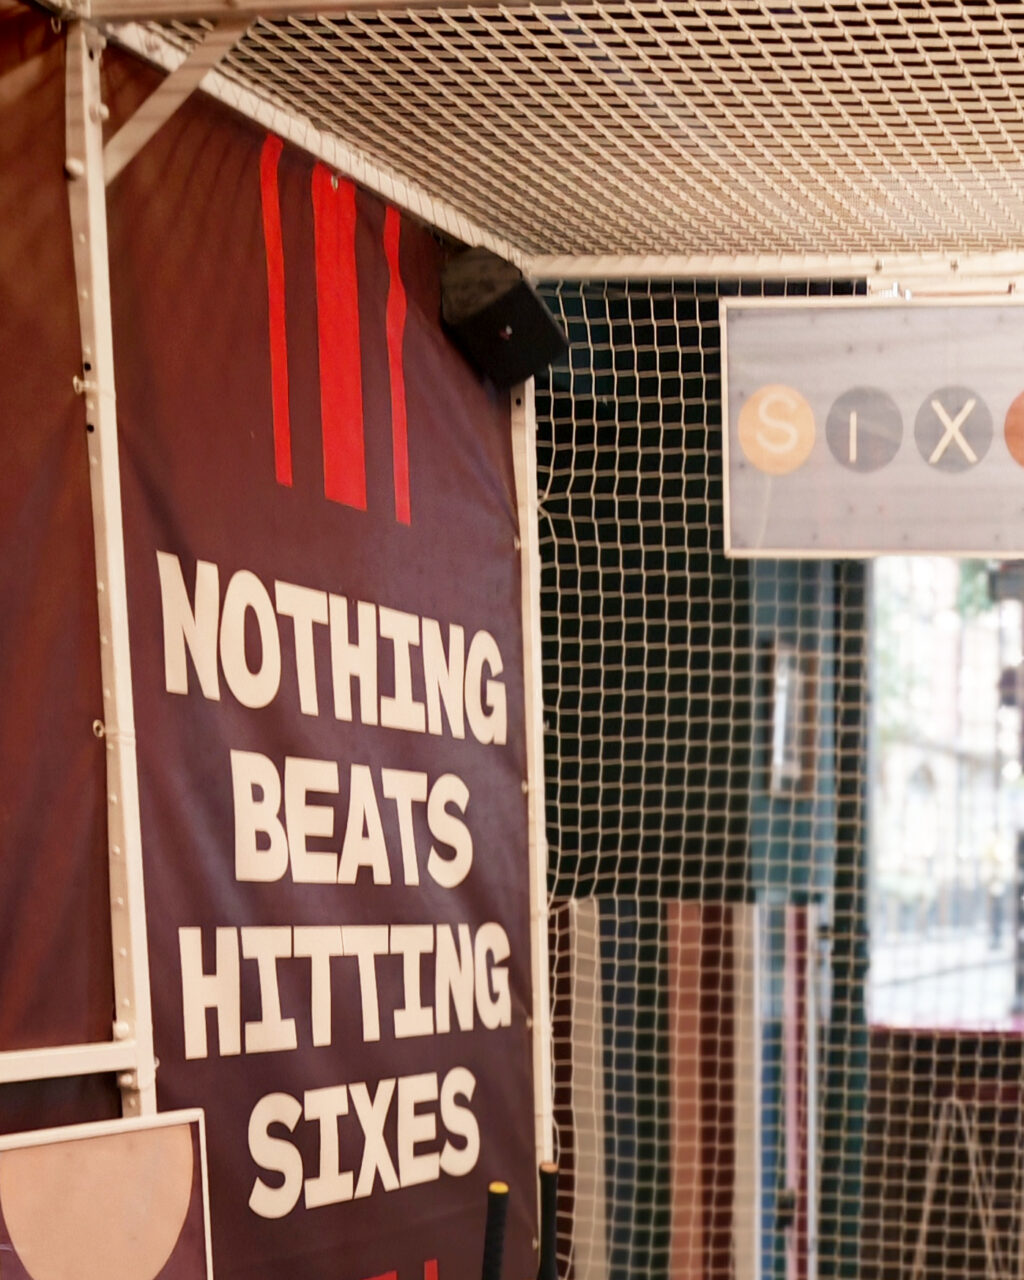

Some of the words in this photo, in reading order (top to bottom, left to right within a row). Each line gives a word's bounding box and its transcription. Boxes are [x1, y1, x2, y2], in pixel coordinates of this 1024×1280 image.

[156, 550, 508, 746] NOTHING
[230, 749, 474, 888] BEATS
[178, 922, 512, 1060] HITTING
[247, 1066, 481, 1219] SIXES
